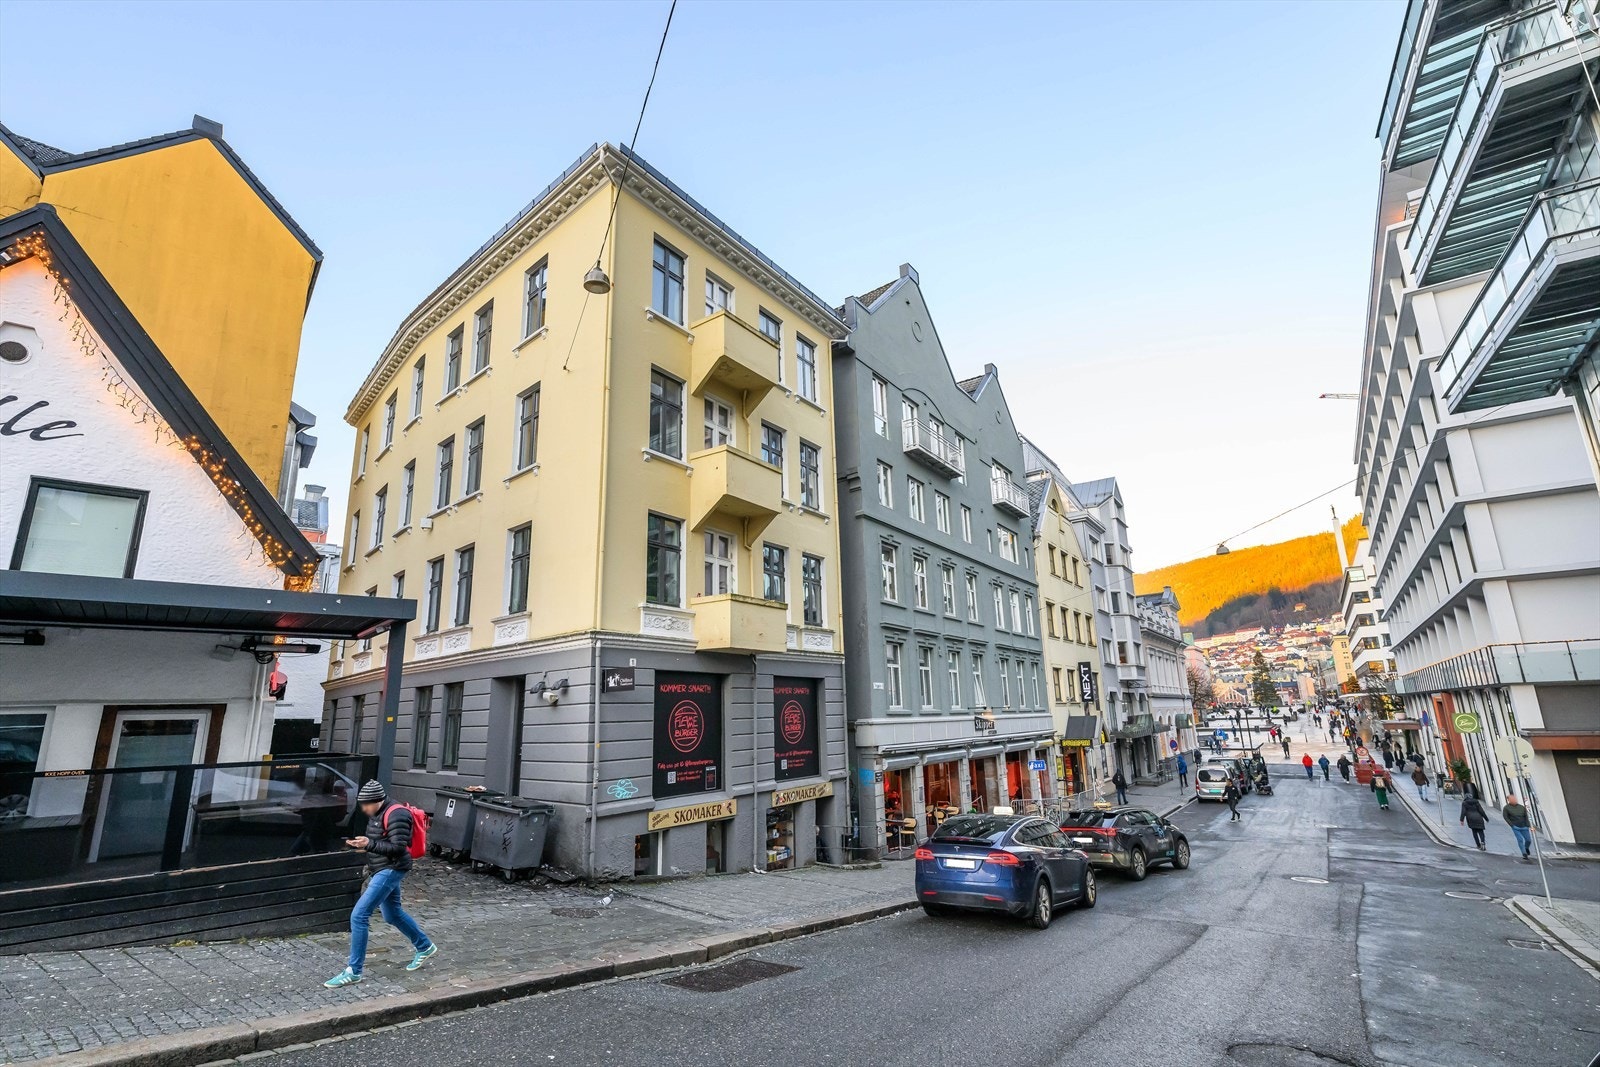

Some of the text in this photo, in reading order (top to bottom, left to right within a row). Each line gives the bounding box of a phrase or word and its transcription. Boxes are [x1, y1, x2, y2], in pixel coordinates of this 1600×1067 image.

[660, 684, 686, 692] KOMMER
[1081, 664, 1092, 700] NEXT
[782, 788, 816, 803] SKOMAKER
[674, 804, 722, 824] SKOMAKER
